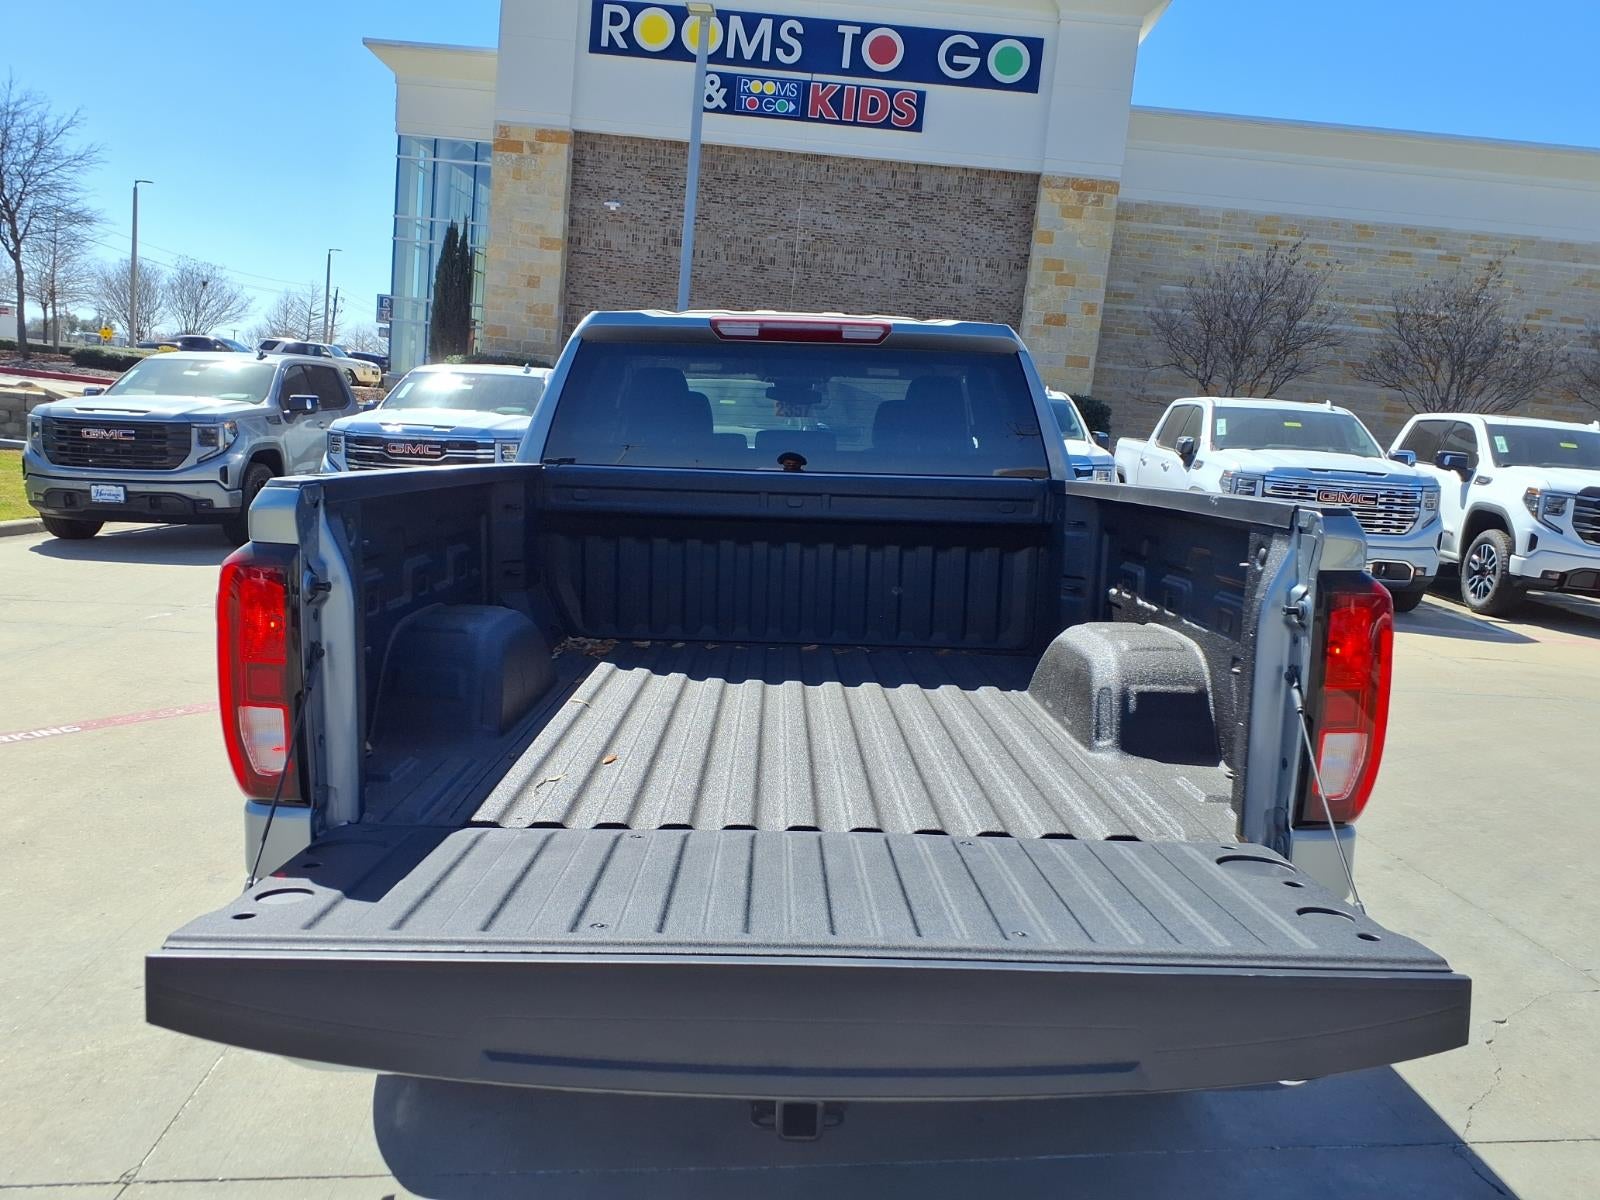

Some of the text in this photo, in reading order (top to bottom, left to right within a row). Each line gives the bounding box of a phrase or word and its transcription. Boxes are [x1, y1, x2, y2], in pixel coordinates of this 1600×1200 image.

[600, 3, 1030, 83] ROOMS TO GO
[703, 73, 728, 109] &
[740, 79, 798, 97] ROOMS
[740, 96, 789, 113] TO GO
[808, 82, 918, 127] KIDS
[81, 428, 136, 440] GMC
[387, 442, 441, 455] GMC
[1319, 490, 1377, 505] GMC
